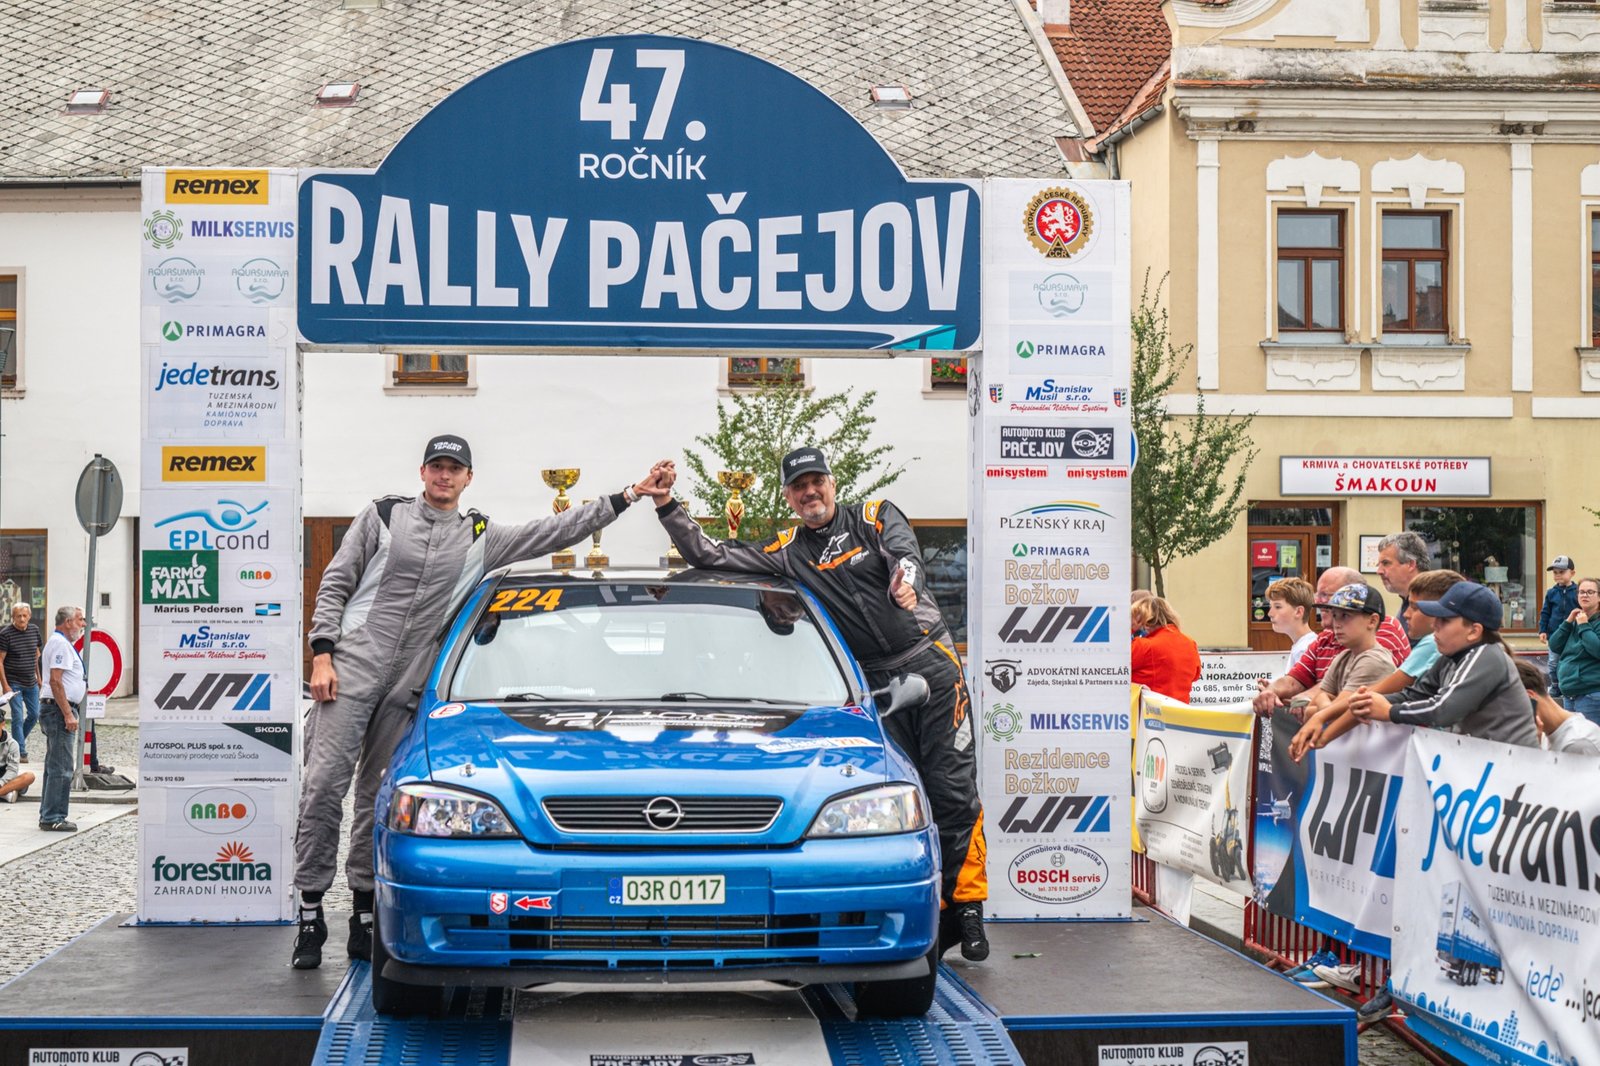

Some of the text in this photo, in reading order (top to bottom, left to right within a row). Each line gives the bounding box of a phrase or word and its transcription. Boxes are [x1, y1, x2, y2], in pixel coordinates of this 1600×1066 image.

[579, 48, 707, 142] 47.
[579, 146, 707, 180] ROČNÍK
[172, 178, 260, 195] Remex
[1027, 198, 1043, 237] AUTOKLUB
[1070, 196, 1090, 238] REPUBLIKY
[191, 220, 295, 239] MILKSERVIS
[310, 179, 970, 312] RALLY PAČEJOV
[186, 325, 266, 337] PRIMAGRA
[1037, 344, 1106, 356] PRIMAGRA
[155, 362, 280, 391] jedetrans
[1025, 386, 1058, 401] Musil
[1042, 379, 1093, 393] Stanislav
[208, 392, 253, 400] TUZEMSKÁ
[216, 402, 277, 410] MEZINÁRODNÍ
[1002, 428, 1066, 438] AUTOMOTO KLUB
[1002, 438, 1065, 457] PAČEJOV
[169, 456, 258, 472] Remex
[1302, 460, 1340, 469] KRMIVA
[1352, 459, 1421, 470] CHOVATELSKÉ
[1424, 459, 1469, 470] POTŘEBY
[1334, 473, 1437, 492] ŠMAKOUN
[1000, 516, 1105, 532] PLZEŇSKÝ KRAJ
[169, 530, 270, 550] EPLcond
[1030, 546, 1090, 556] PRIMAGRA
[240, 570, 272, 580] ARBO
[1004, 558, 1110, 581] Rezidence
[488, 588, 564, 613] 224
[1004, 583, 1080, 606] Božkov
[154, 605, 244, 614] Marius Pedersen
[198, 626, 250, 640] Stanislav
[179, 634, 213, 648] Musil
[1027, 666, 1130, 676] ADVOKÁTNÍ KANCELÁŘ
[1206, 672, 1272, 680] HORAŽĎOVICE
[1030, 714, 1129, 730] MILKSERVIS
[208, 742, 225, 751] spol.
[144, 752, 188, 760] Autorizovaný
[190, 752, 218, 760] prodejce
[1004, 748, 1110, 770] Rezidence
[1004, 772, 1080, 795] Božkov
[191, 803, 247, 820] ARBO
[1063, 845, 1102, 866] diagnostika
[152, 856, 272, 882] forestina
[1017, 870, 1101, 884] BOSCH servis
[154, 884, 272, 896] ZAHRADNÍ HNOJIVA
[626, 879, 722, 901] 03R 0117
[609, 896, 622, 904] CZ
[1528, 896, 1536, 910] A
[32, 1051, 120, 1063] AUTOMOTO KLUB
[1102, 1046, 1184, 1060] AUTOMOTO KLUB
